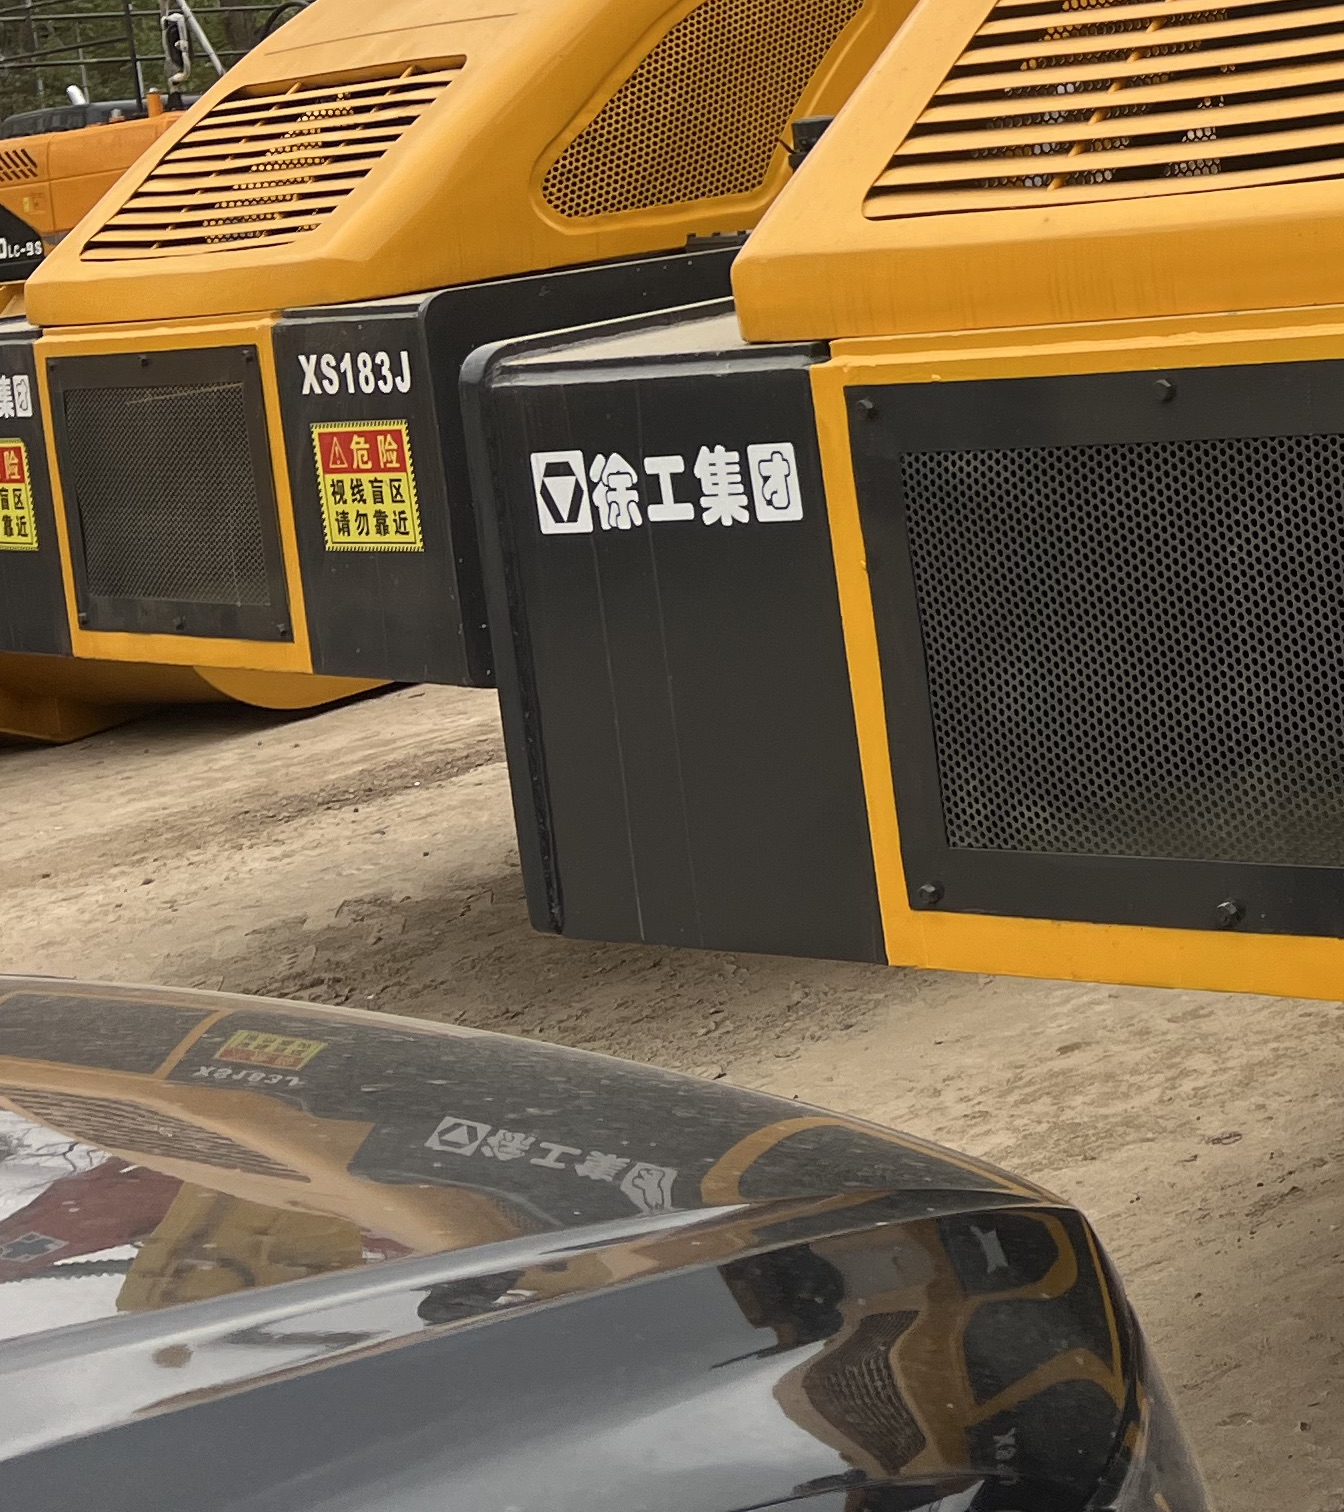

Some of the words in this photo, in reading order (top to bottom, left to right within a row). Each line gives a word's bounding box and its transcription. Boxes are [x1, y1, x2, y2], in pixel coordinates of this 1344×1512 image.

[297, 350, 412, 396] XS183J
[349, 433, 401, 470] 危险
[330, 476, 406, 505] 视线盲区
[588, 441, 804, 531] 徐工集团
[334, 509, 411, 538] 请勿靠近
